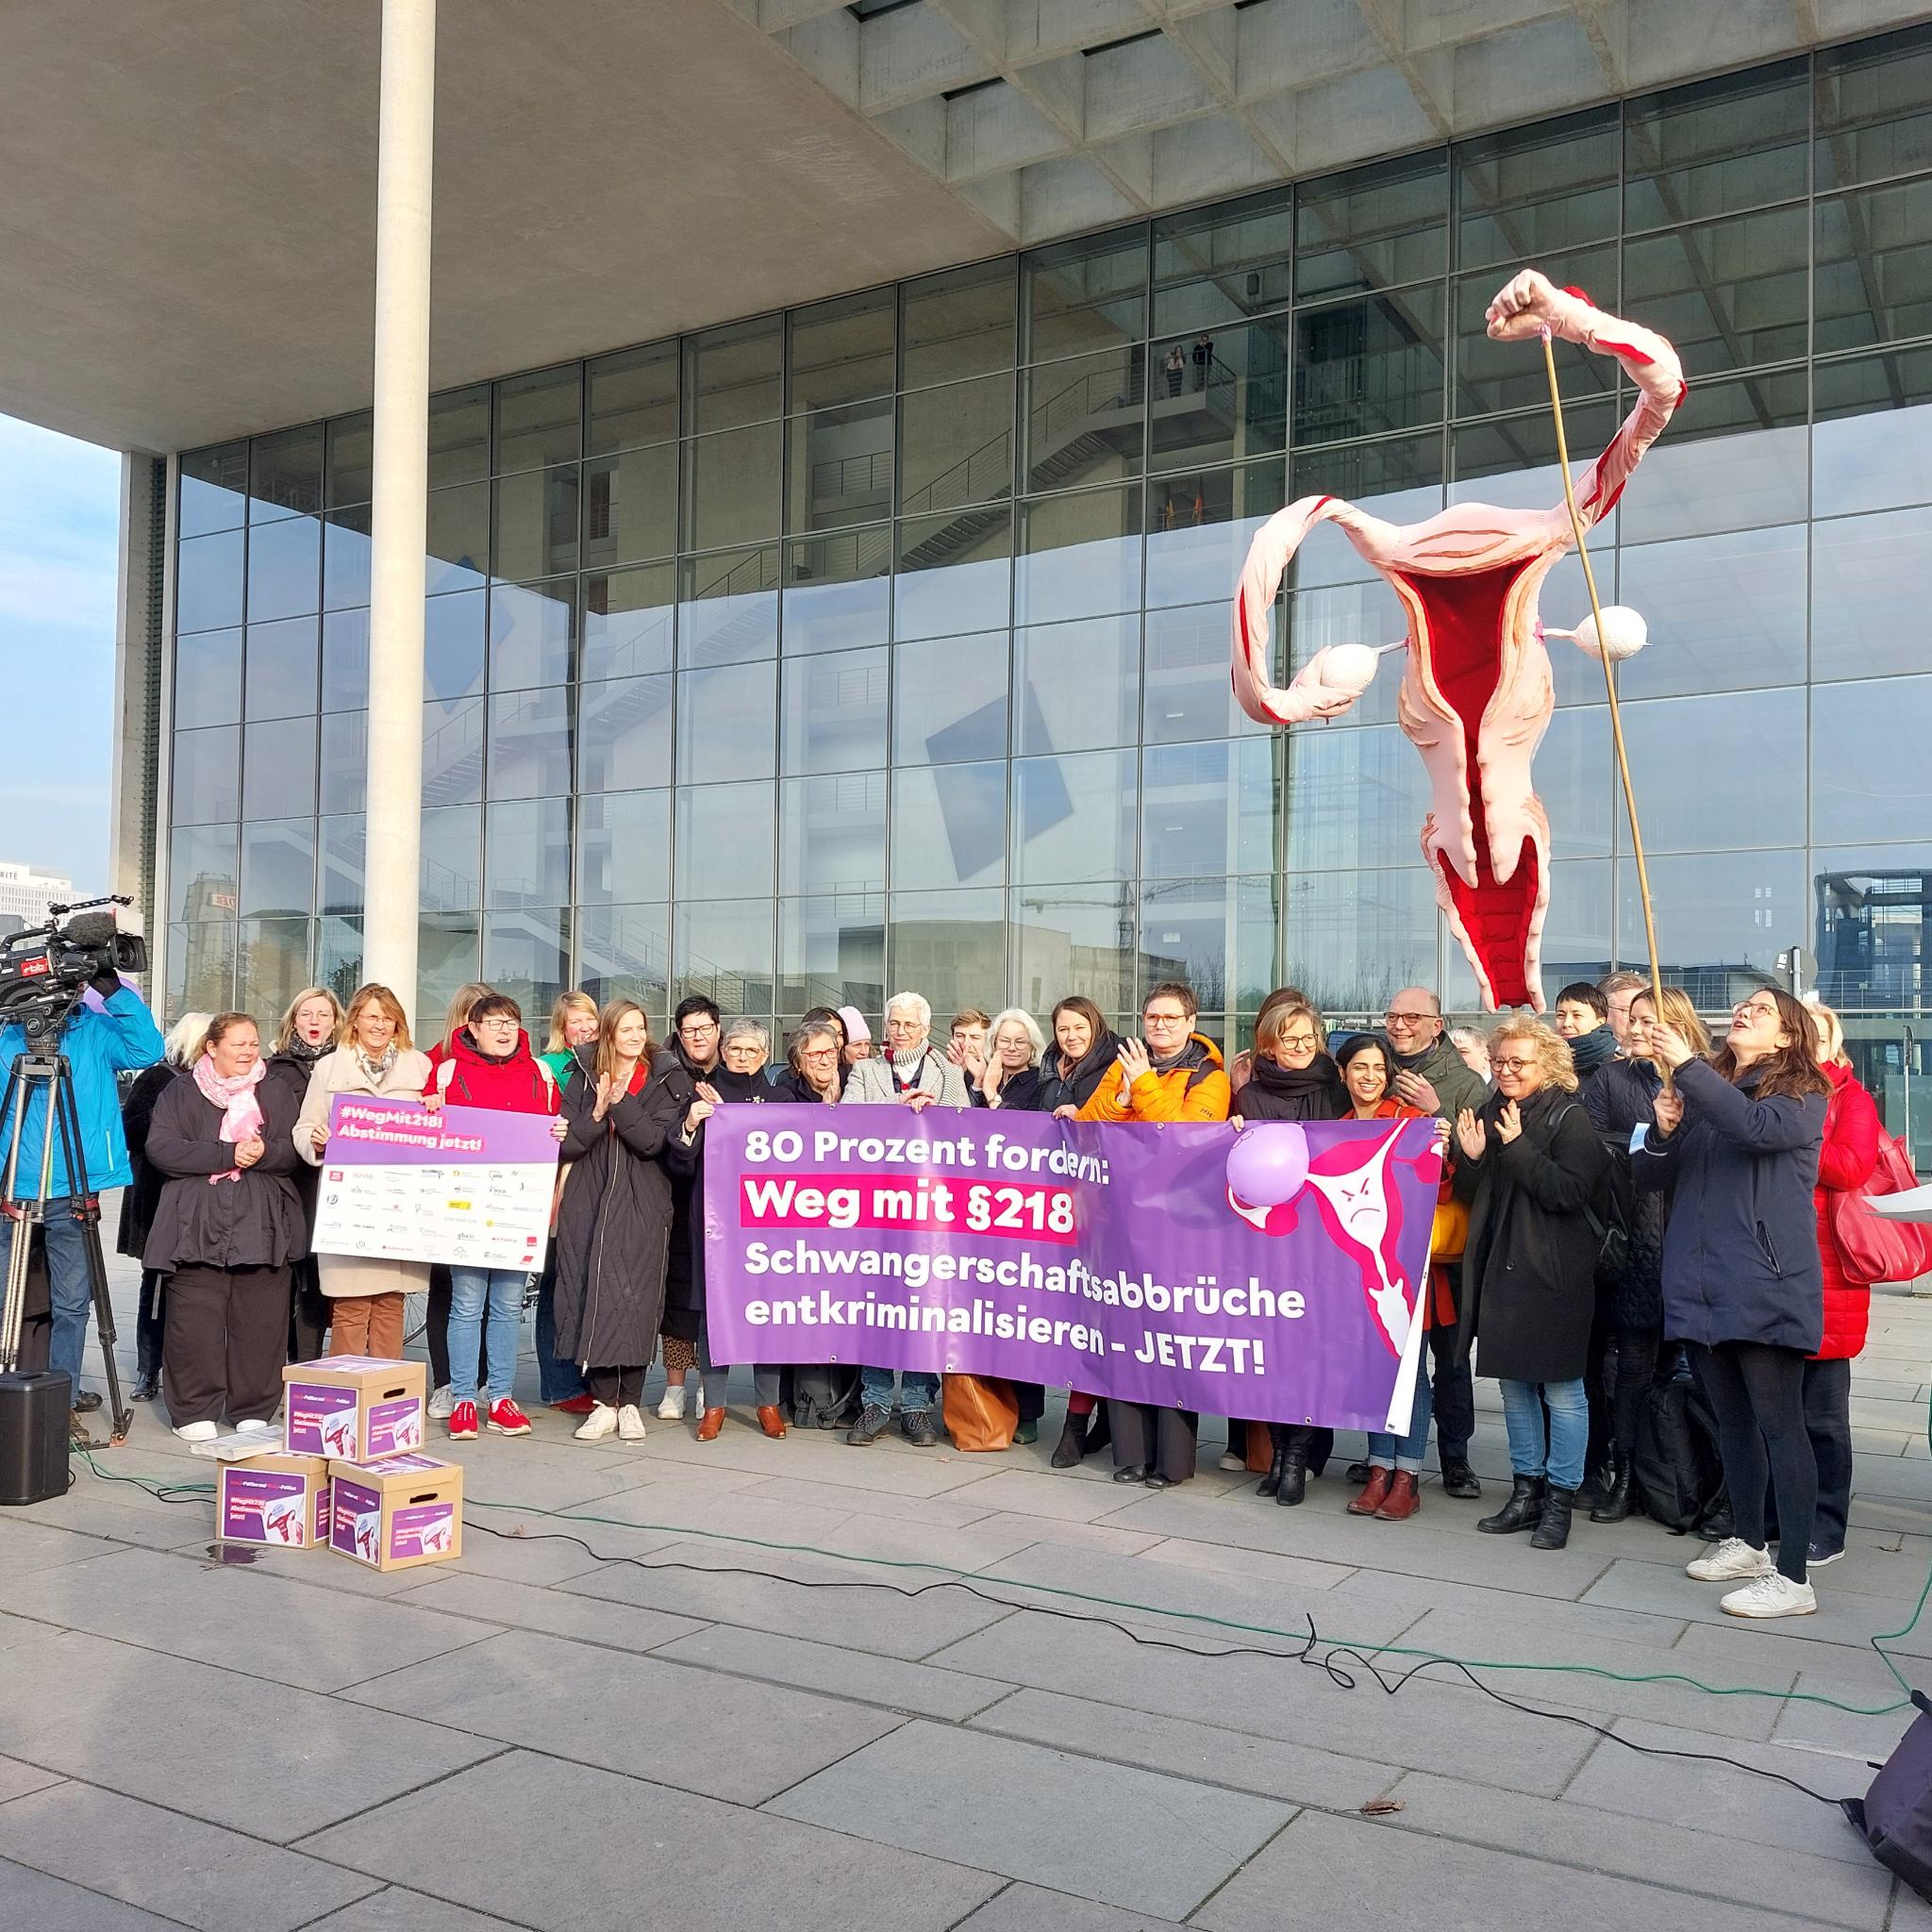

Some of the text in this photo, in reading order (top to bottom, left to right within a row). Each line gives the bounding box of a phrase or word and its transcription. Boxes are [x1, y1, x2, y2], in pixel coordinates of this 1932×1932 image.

[338, 1124, 482, 1151] Abstimmung jetzt!
[340, 1105, 443, 1129] #WegMit218!
[744, 1130, 1110, 1185] 80 Prozent fordern:
[743, 1177, 1074, 1234] Weg mit §218
[744, 1240, 1306, 1319] Schwangerschaftsabbrüche
[744, 1290, 1105, 1357] entkriminalisieren
[1134, 1330, 1266, 1375] JETZT!
